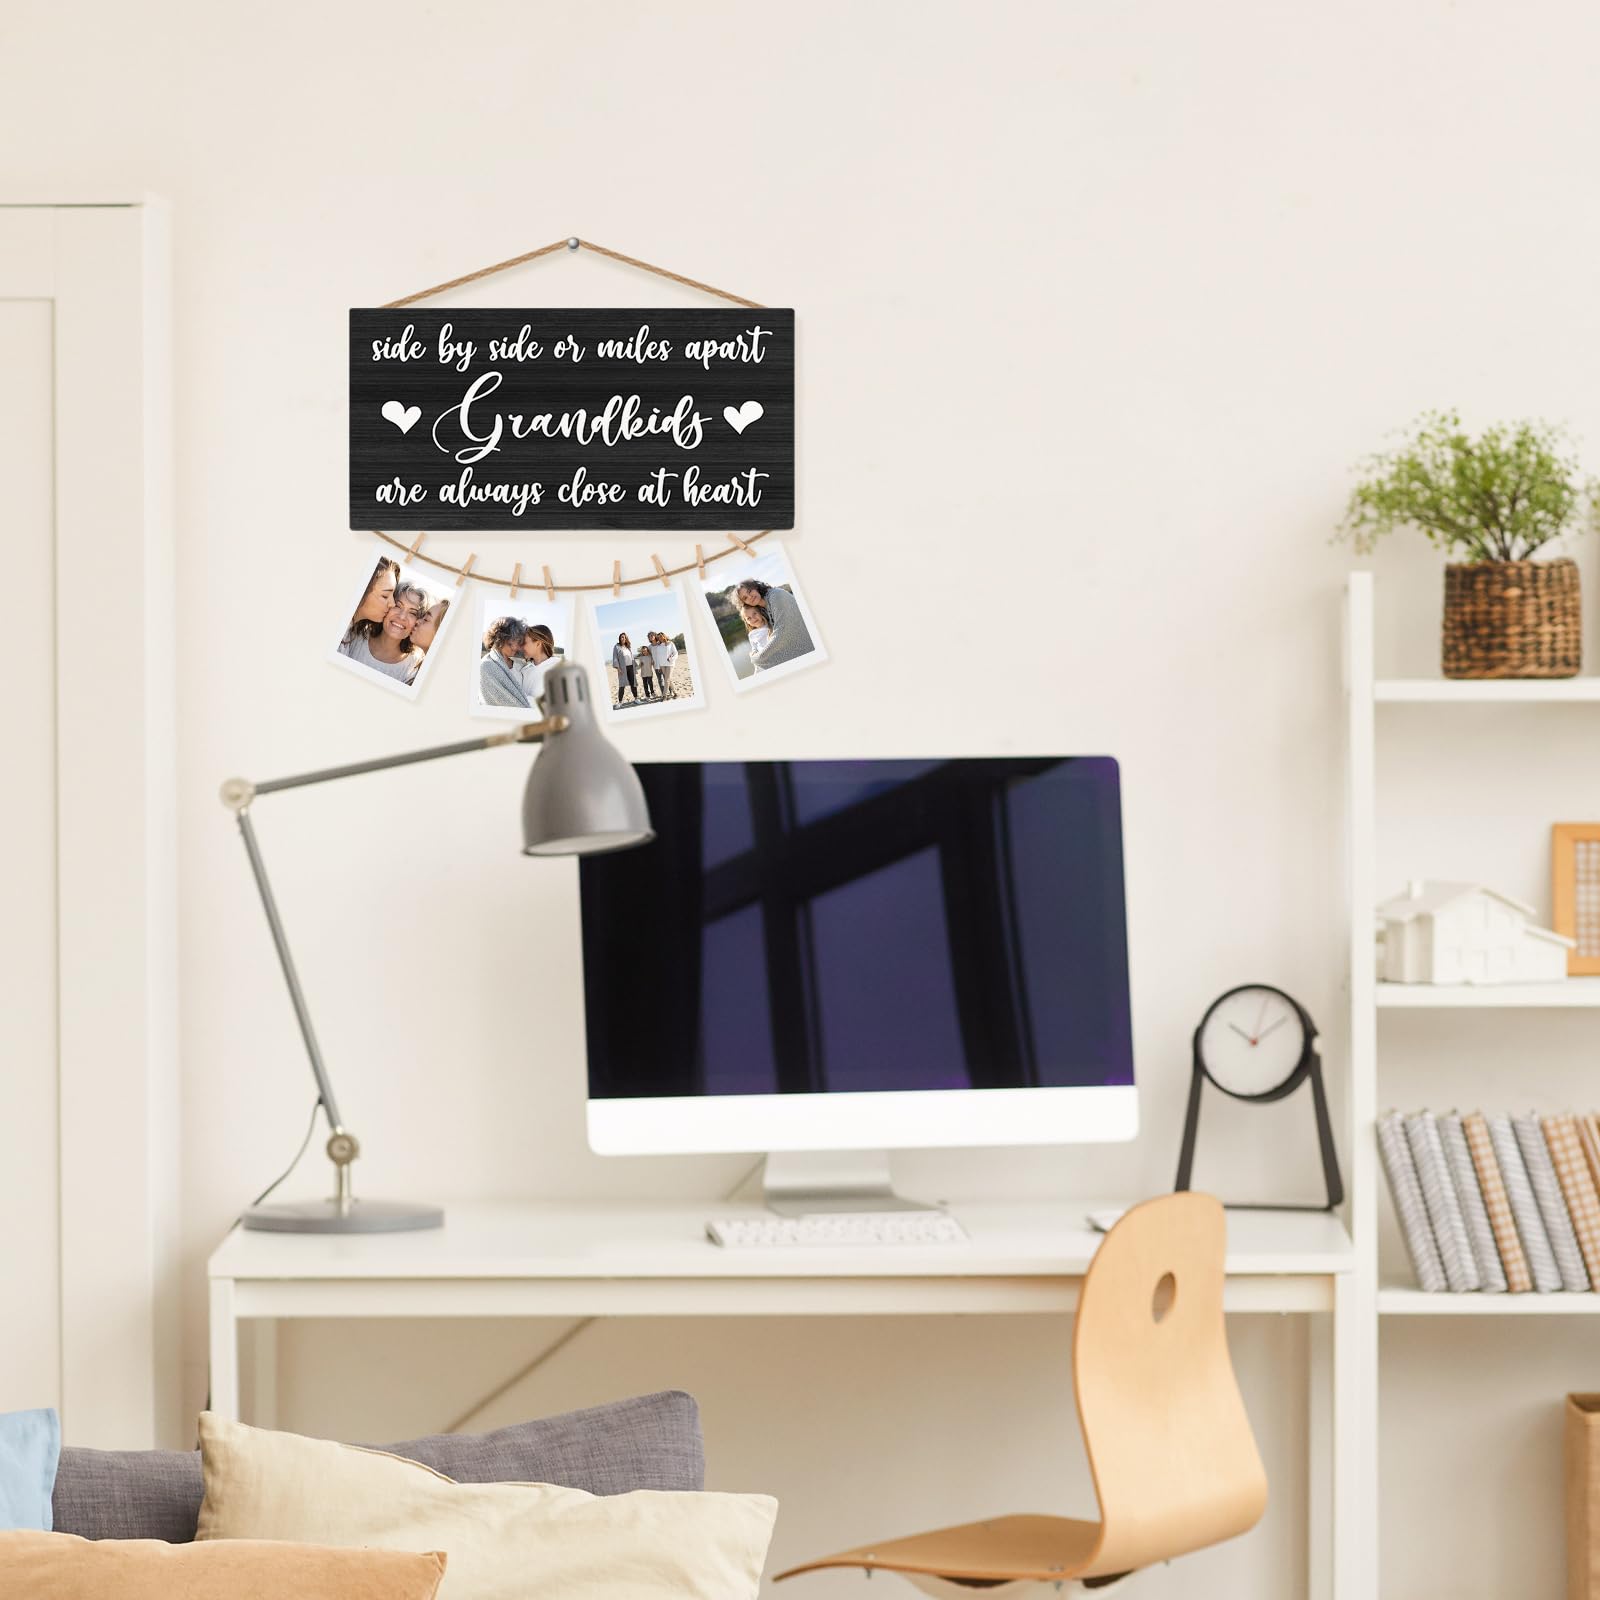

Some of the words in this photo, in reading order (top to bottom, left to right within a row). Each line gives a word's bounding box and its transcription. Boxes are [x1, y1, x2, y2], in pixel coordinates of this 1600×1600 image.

[372, 324, 427, 363] side
[438, 322, 478, 373] by
[488, 324, 544, 363] side
[553, 334, 586, 363] or
[597, 324, 674, 364] miles
[684, 325, 774, 371] apart
[432, 371, 713, 465] Grandkids
[375, 476, 428, 507] are
[438, 466, 546, 517] always
[557, 466, 627, 508] close
[637, 467, 679, 508] at
[683, 465, 770, 508] heart
